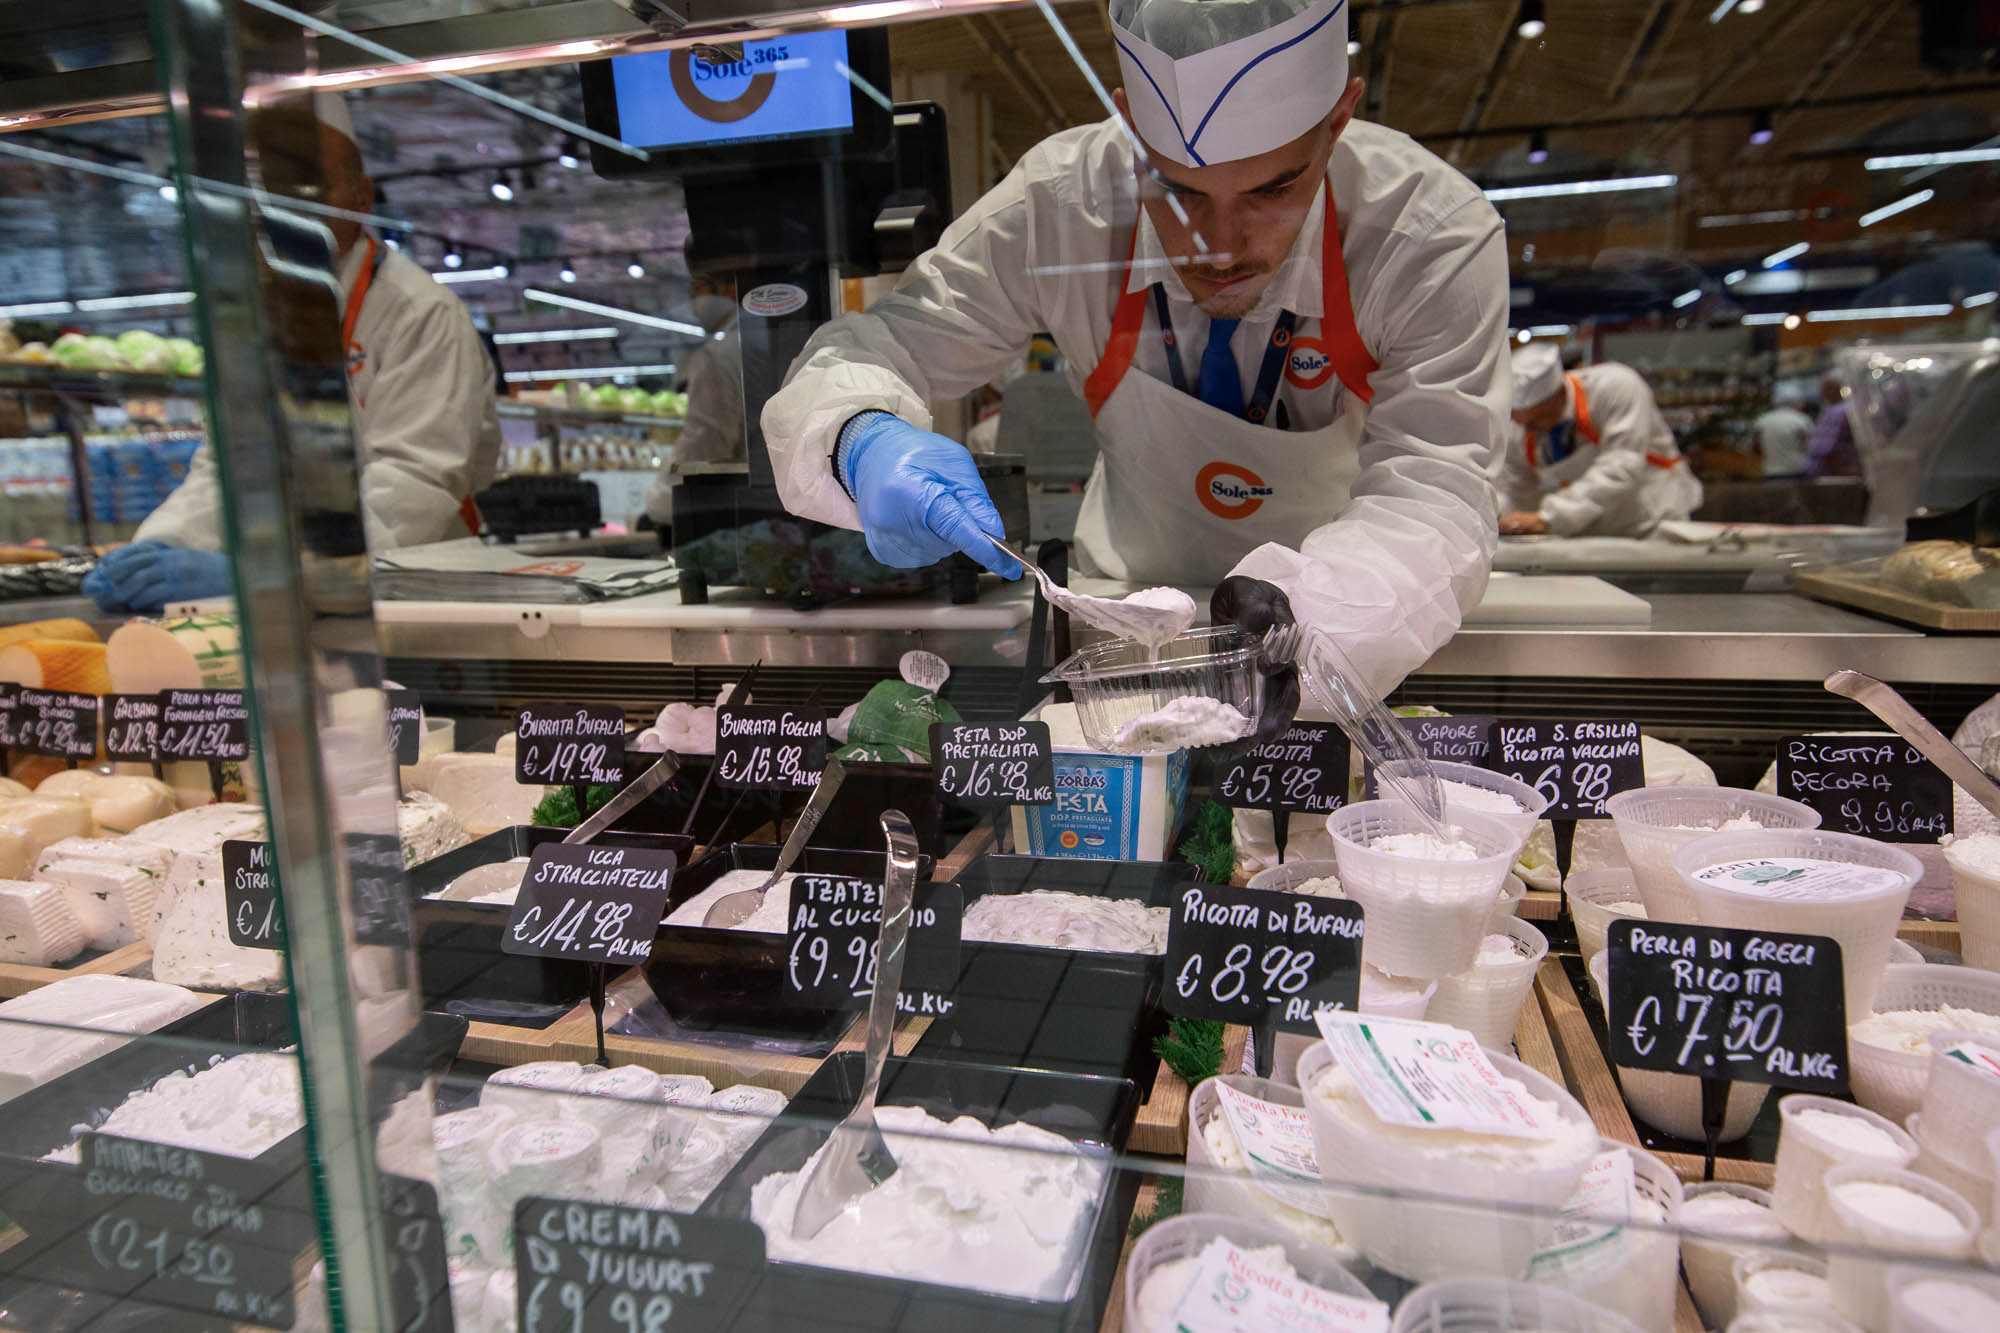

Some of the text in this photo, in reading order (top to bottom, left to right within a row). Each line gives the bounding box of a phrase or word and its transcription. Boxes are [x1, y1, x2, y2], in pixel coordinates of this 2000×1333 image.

[114, 697, 158, 719] GALBANO
[519, 709, 624, 738] BURRATA BUFALA
[720, 712, 822, 738] BURRATA FOGLIA
[953, 726, 1027, 743] FETA DOP
[1419, 722, 1478, 742] SAPORE
[1500, 722, 1638, 745] ICCA S. ERSILIA
[942, 742, 1039, 759] PRETAGLIATA
[1503, 741, 1640, 763] RICOTTA VACCINA
[1791, 770, 1893, 792] PECORA
[1056, 793, 1109, 813] FETA
[588, 849, 625, 866] ICCA
[534, 861, 669, 891] STRACCIATELLA
[793, 904, 819, 931] AL
[1182, 888, 1364, 938] RICOTTA DI BUFALA
[1630, 928, 1816, 965] PERLA DI GRECI
[1671, 959, 1783, 996] RICOTTA
[540, 1204, 681, 1250] CREMA
